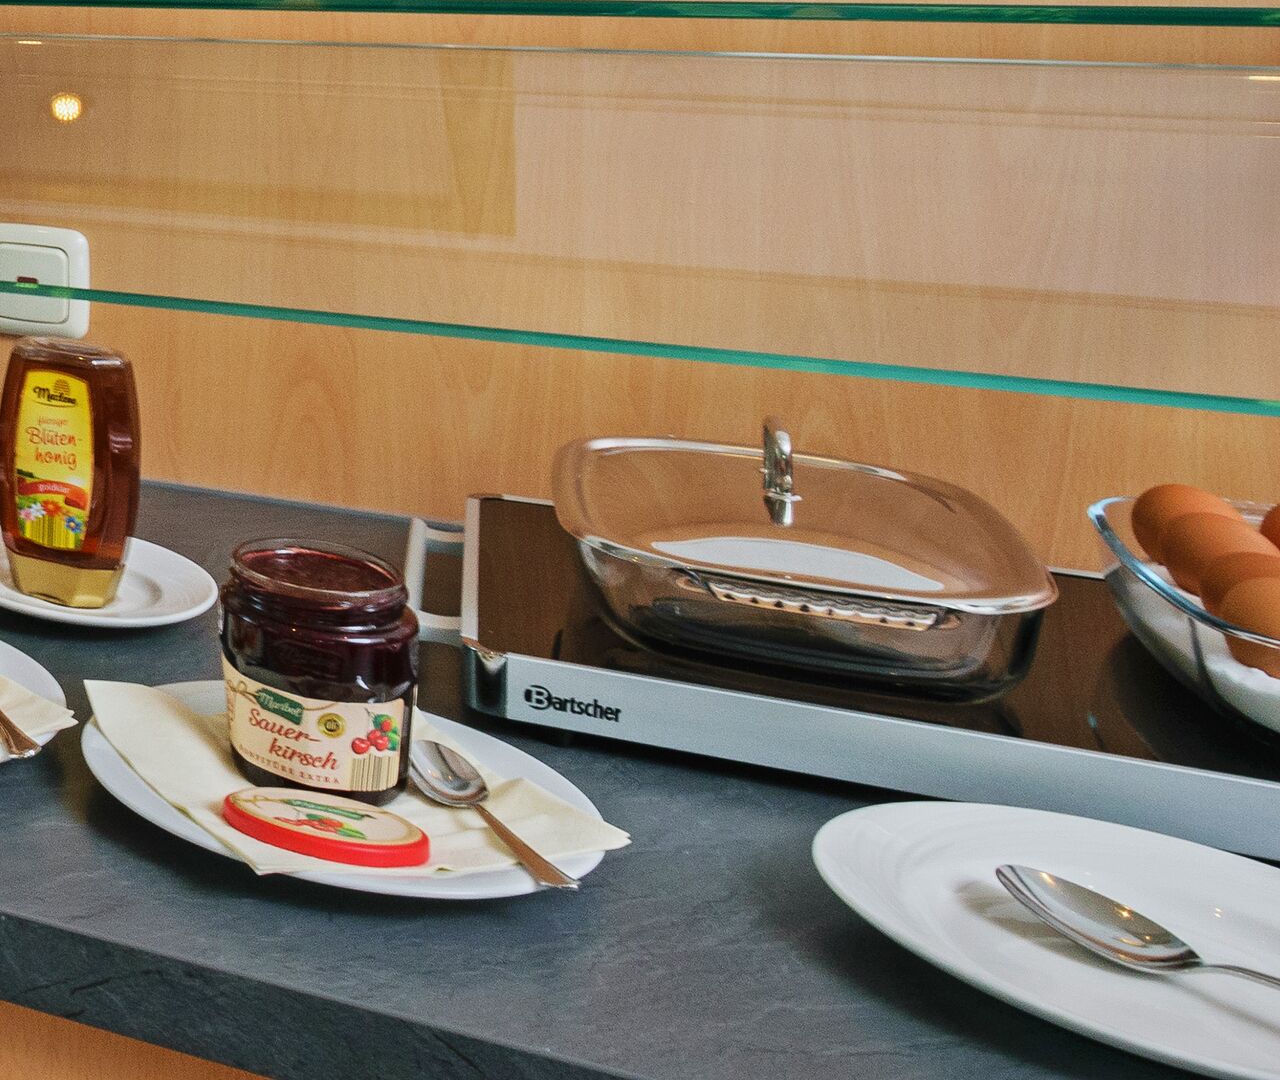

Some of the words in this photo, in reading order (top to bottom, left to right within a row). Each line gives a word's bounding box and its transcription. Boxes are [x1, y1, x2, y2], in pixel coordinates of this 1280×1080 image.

[26, 426, 83, 447] Blüten-
[34, 447, 77, 471] honig
[524, 684, 622, 723] Bartscher
[268, 737, 338, 770] kirsch
